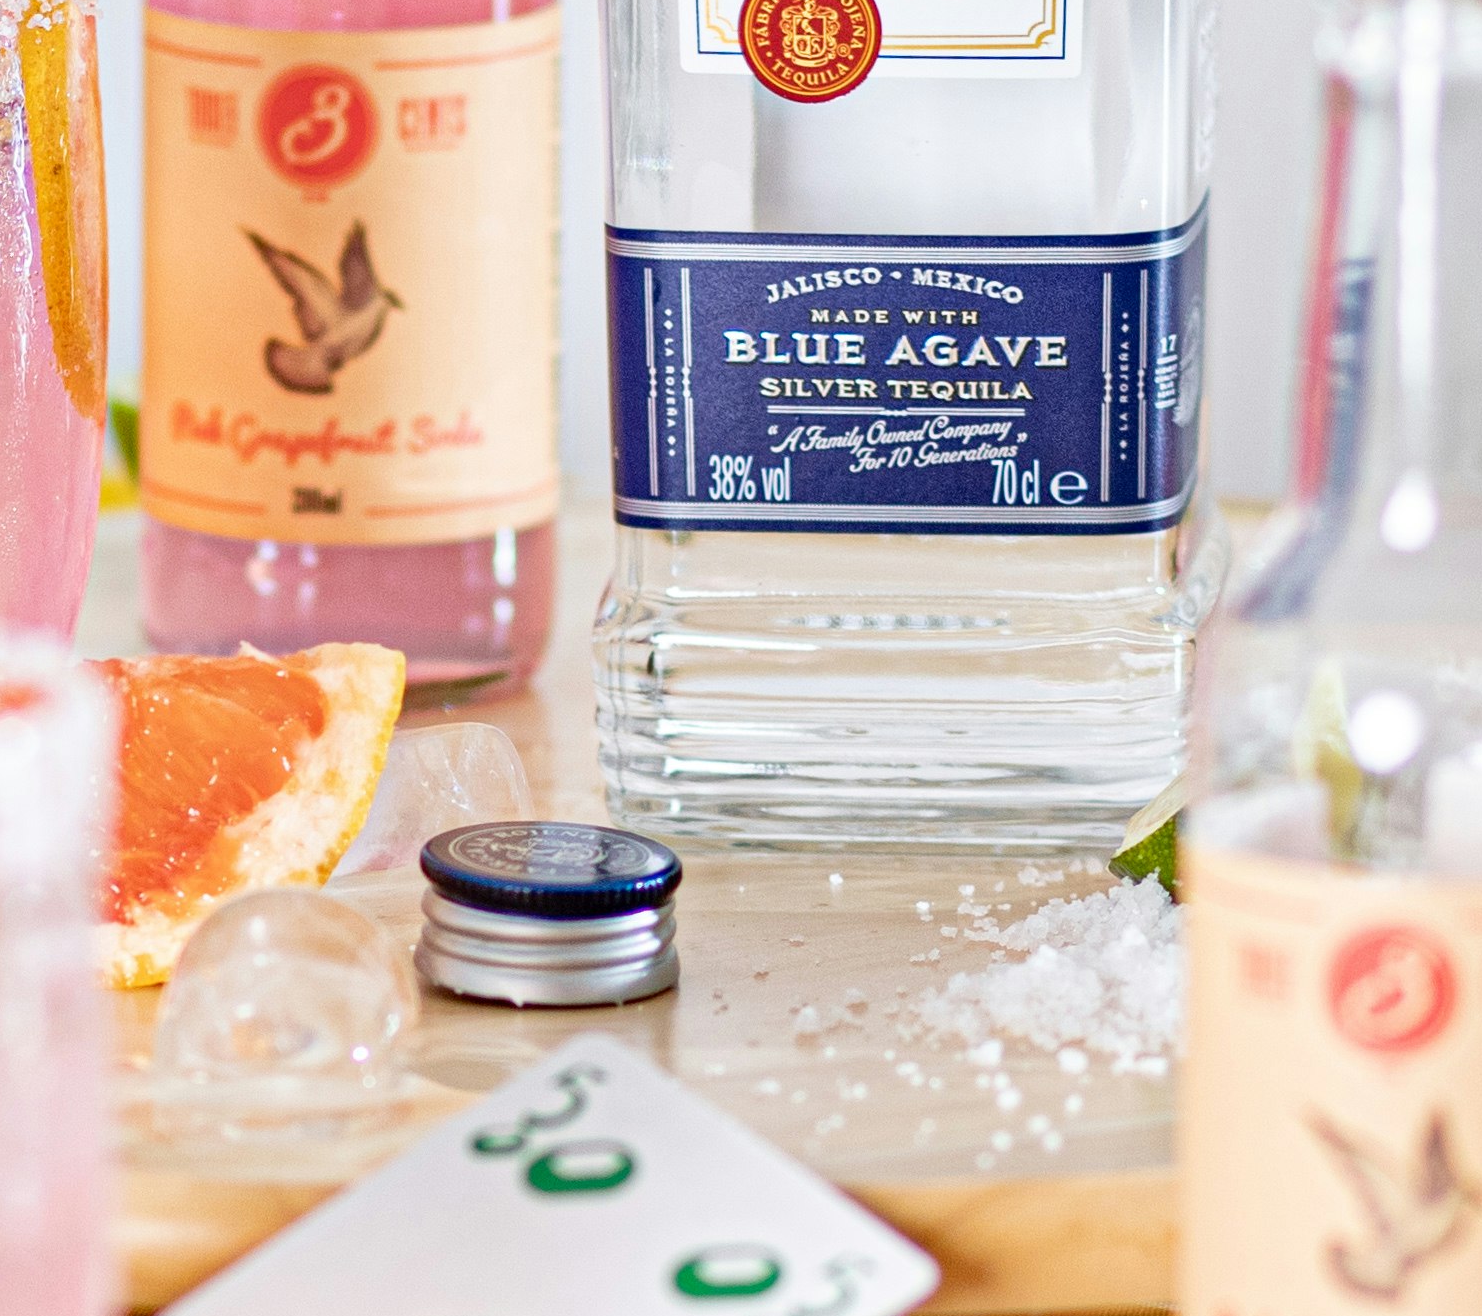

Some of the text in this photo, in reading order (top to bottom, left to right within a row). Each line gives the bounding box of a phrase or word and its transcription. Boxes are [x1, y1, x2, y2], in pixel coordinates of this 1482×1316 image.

[771, 58, 850, 88] TEQUILA
[766, 267, 1025, 305] JALISCO MEXICO
[810, 308, 979, 325] MADE WITH
[664, 337, 675, 357] LA
[723, 330, 1068, 367] BLUE AGAVE
[760, 377, 1034, 401] SILVER TEQUILA
[800, 425, 864, 455] Family
[866, 420, 927, 446] Owned
[928, 416, 1012, 444] Company
[1118, 412, 1129, 432] LA
[849, 446, 887, 473] For
[888, 445, 910, 468] 10
[709, 454, 791, 502] 38% vol
[991, 459, 1018, 504] 70
[1022, 459, 1039, 505] cl
